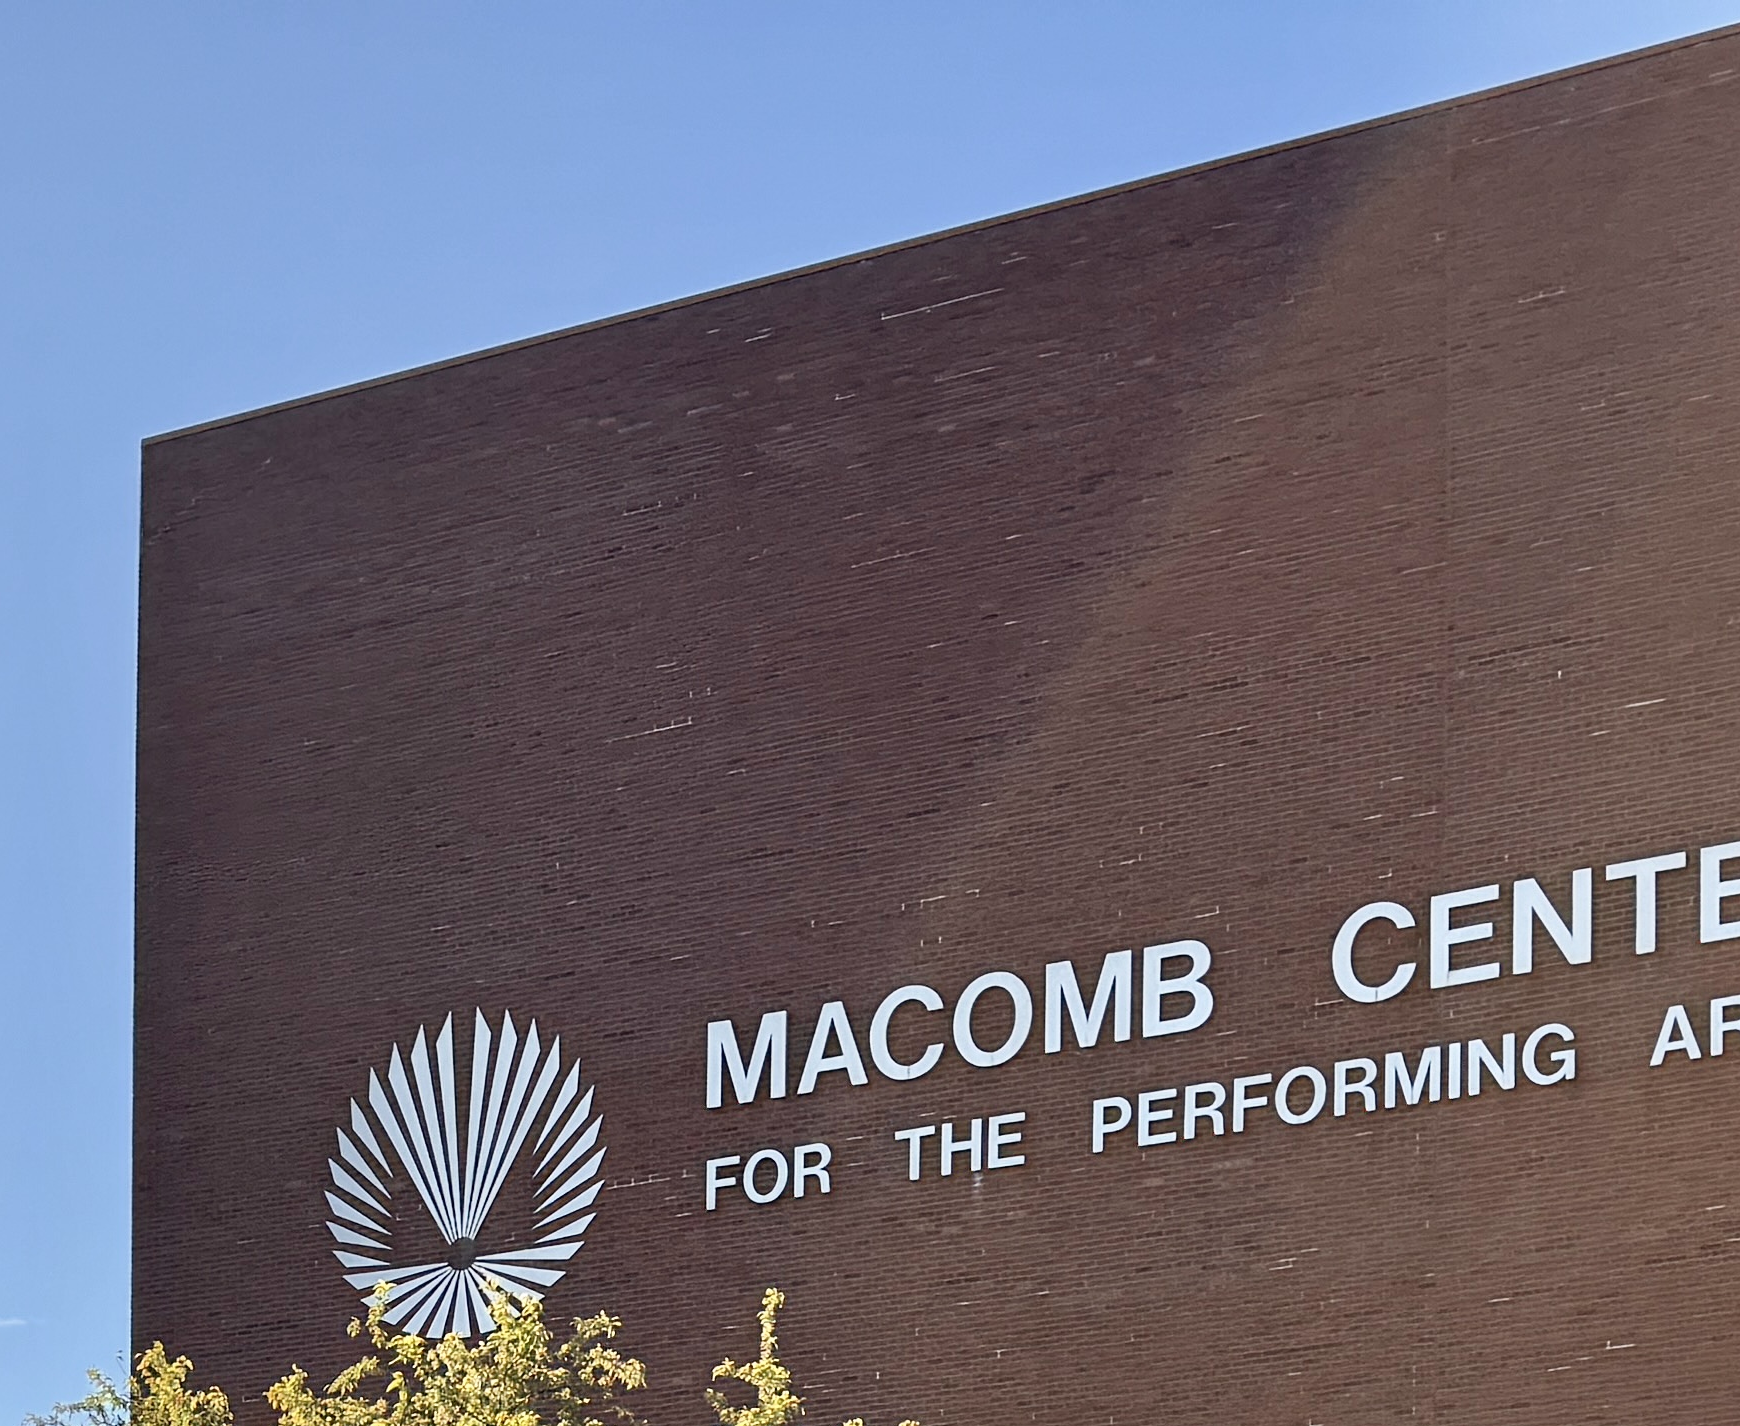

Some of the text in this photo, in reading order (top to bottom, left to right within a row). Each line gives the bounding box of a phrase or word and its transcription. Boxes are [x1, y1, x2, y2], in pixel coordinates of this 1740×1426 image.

[706, 939, 1214, 1109] MACOMB
[705, 1142, 832, 1211] FOR
[894, 1111, 1026, 1181] THE
[1092, 1022, 1576, 1154] PERFORMING
